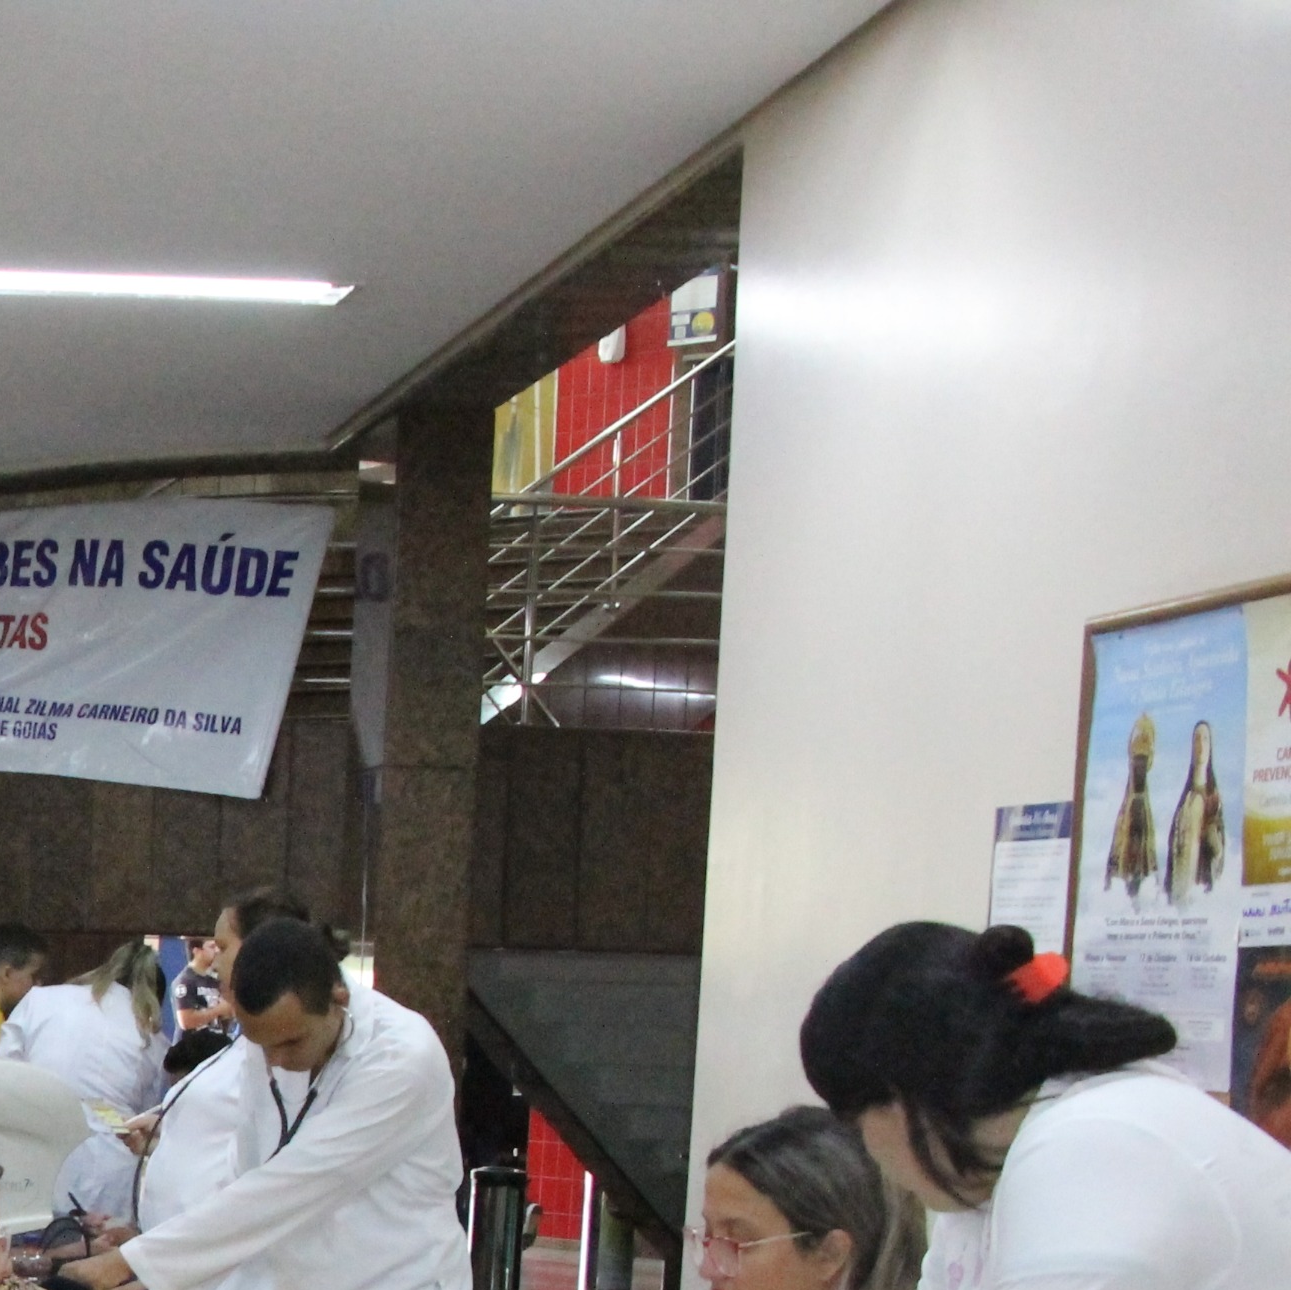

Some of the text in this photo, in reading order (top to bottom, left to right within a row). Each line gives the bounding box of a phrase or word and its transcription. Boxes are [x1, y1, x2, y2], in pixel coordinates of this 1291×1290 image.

[68, 539, 124, 587] NA
[138, 532, 300, 597] SAÚDE
[24, 698, 73, 718] ZILMA
[77, 703, 159, 725] CARNEIRO
[164, 709, 186, 729] DA
[192, 712, 242, 735] SILVA
